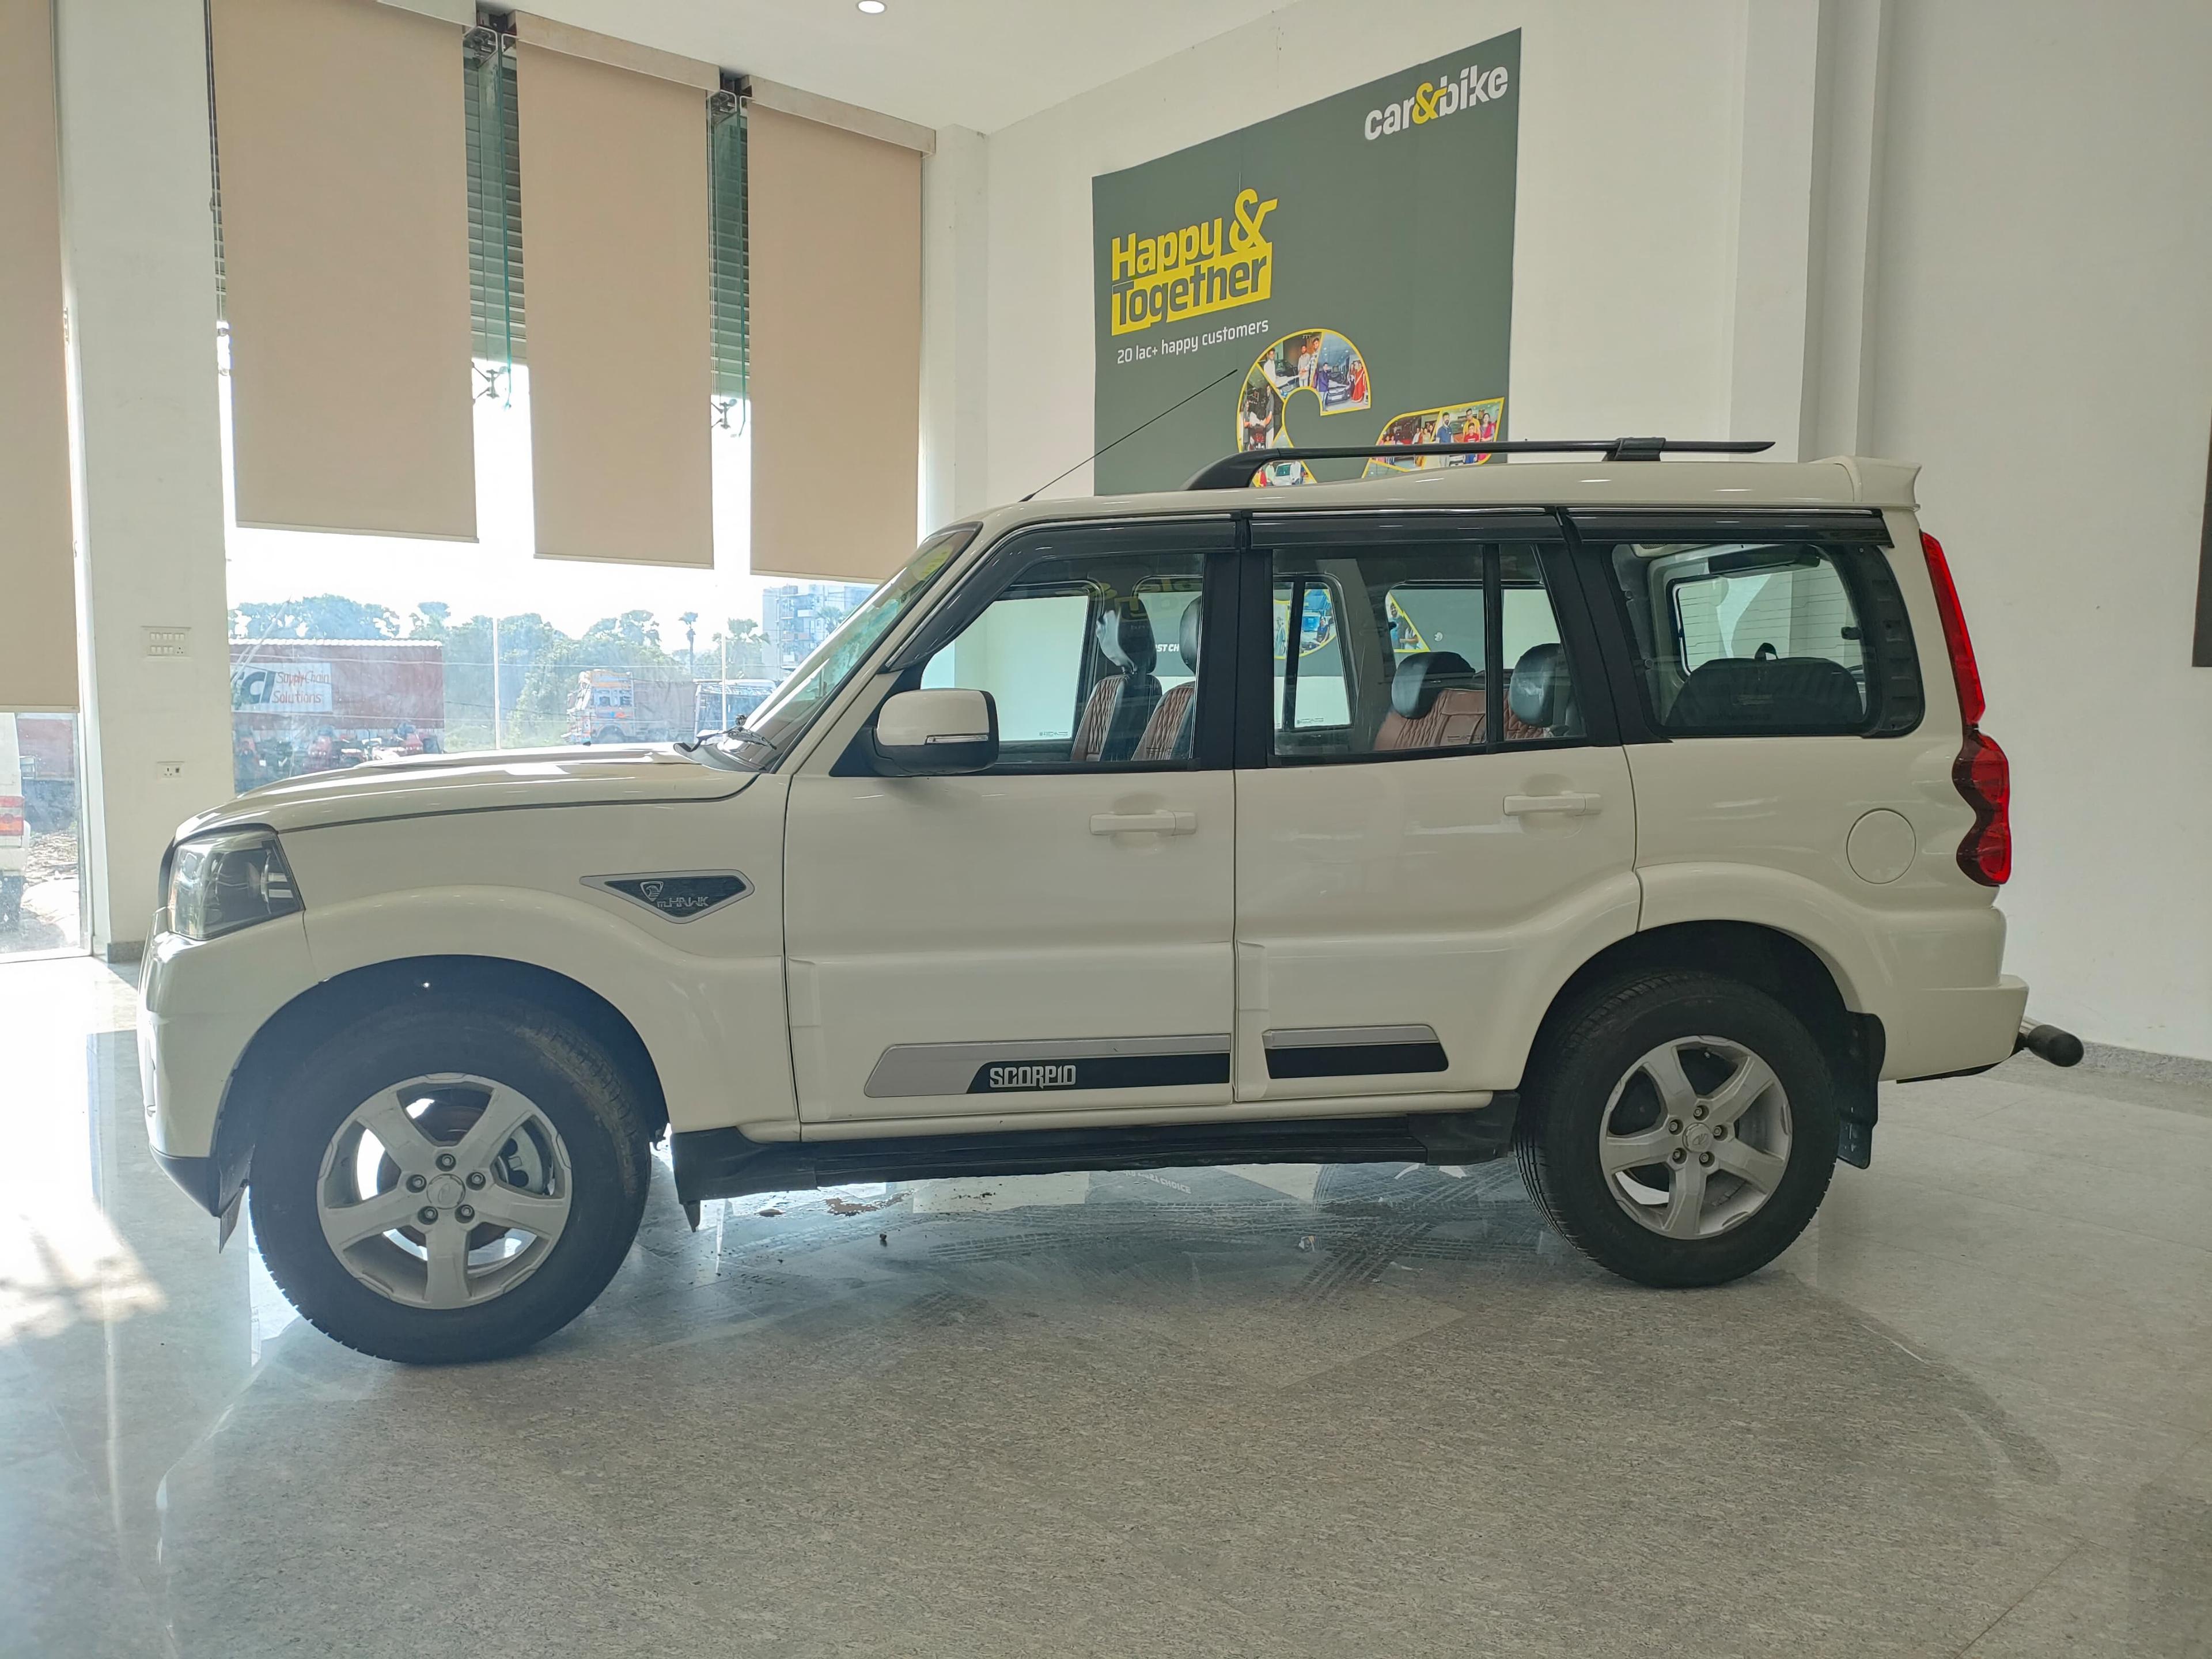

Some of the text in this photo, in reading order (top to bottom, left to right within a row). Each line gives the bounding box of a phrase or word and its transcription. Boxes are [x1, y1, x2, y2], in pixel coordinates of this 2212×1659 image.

[1365, 65, 1508, 140] car&bike
[1111, 188, 1278, 281] Happy &
[1112, 256, 1267, 326] Together
[1117, 320, 1269, 364] 20 lac+ happy customers
[272, 691, 323, 703] Solutions
[990, 1065, 1076, 1089] SCORPIO
